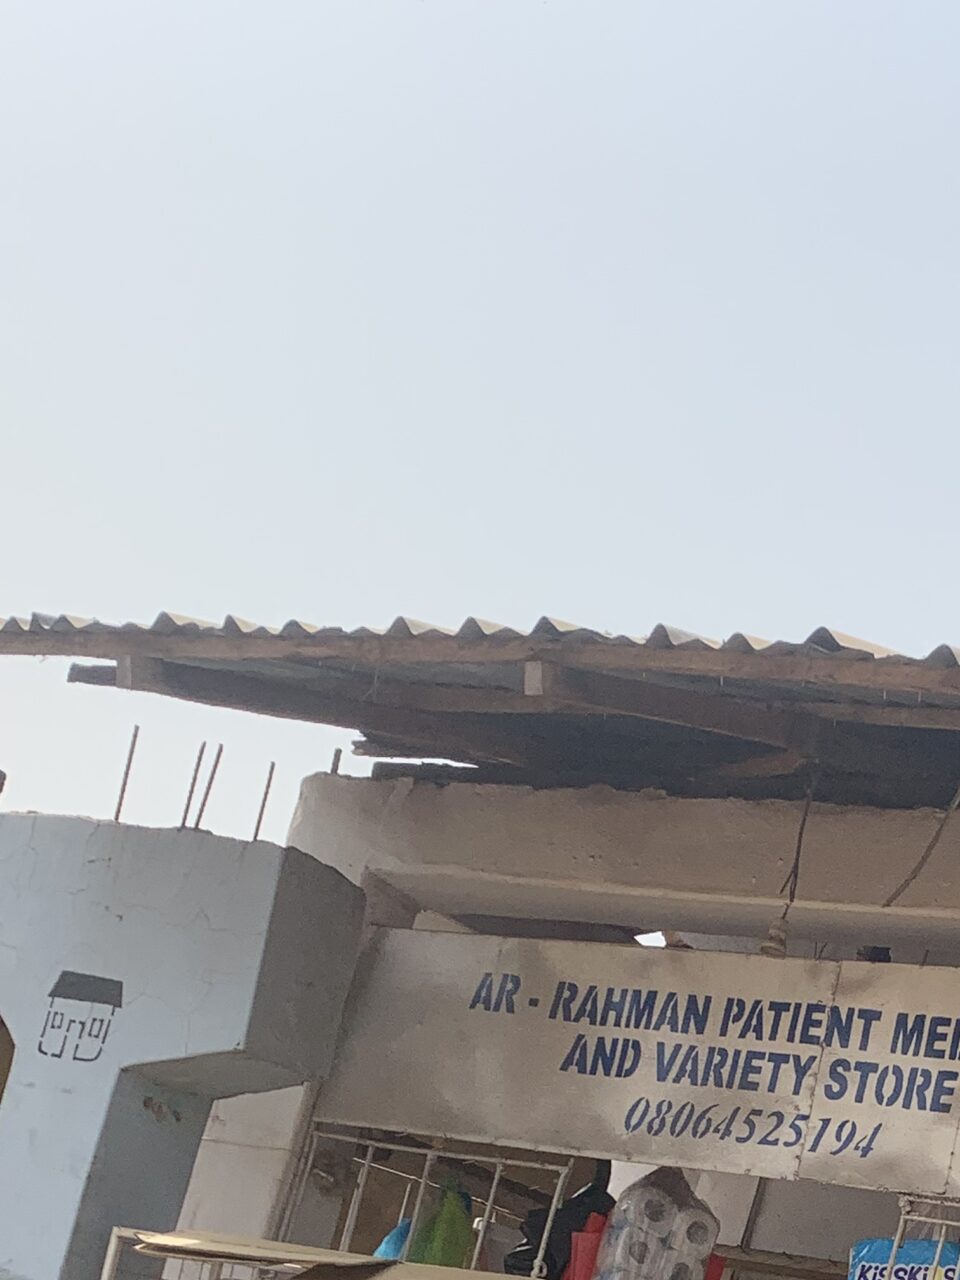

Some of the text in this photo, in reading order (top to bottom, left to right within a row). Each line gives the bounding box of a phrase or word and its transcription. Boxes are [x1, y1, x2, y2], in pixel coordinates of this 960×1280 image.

[469, 972, 521, 1014] AR
[548, 981, 712, 1035] RAHMAN
[719, 997, 882, 1051] PATIENT
[559, 1034, 959, 1113] AND VARIETY STORE
[624, 1096, 883, 1158] 08064525194
